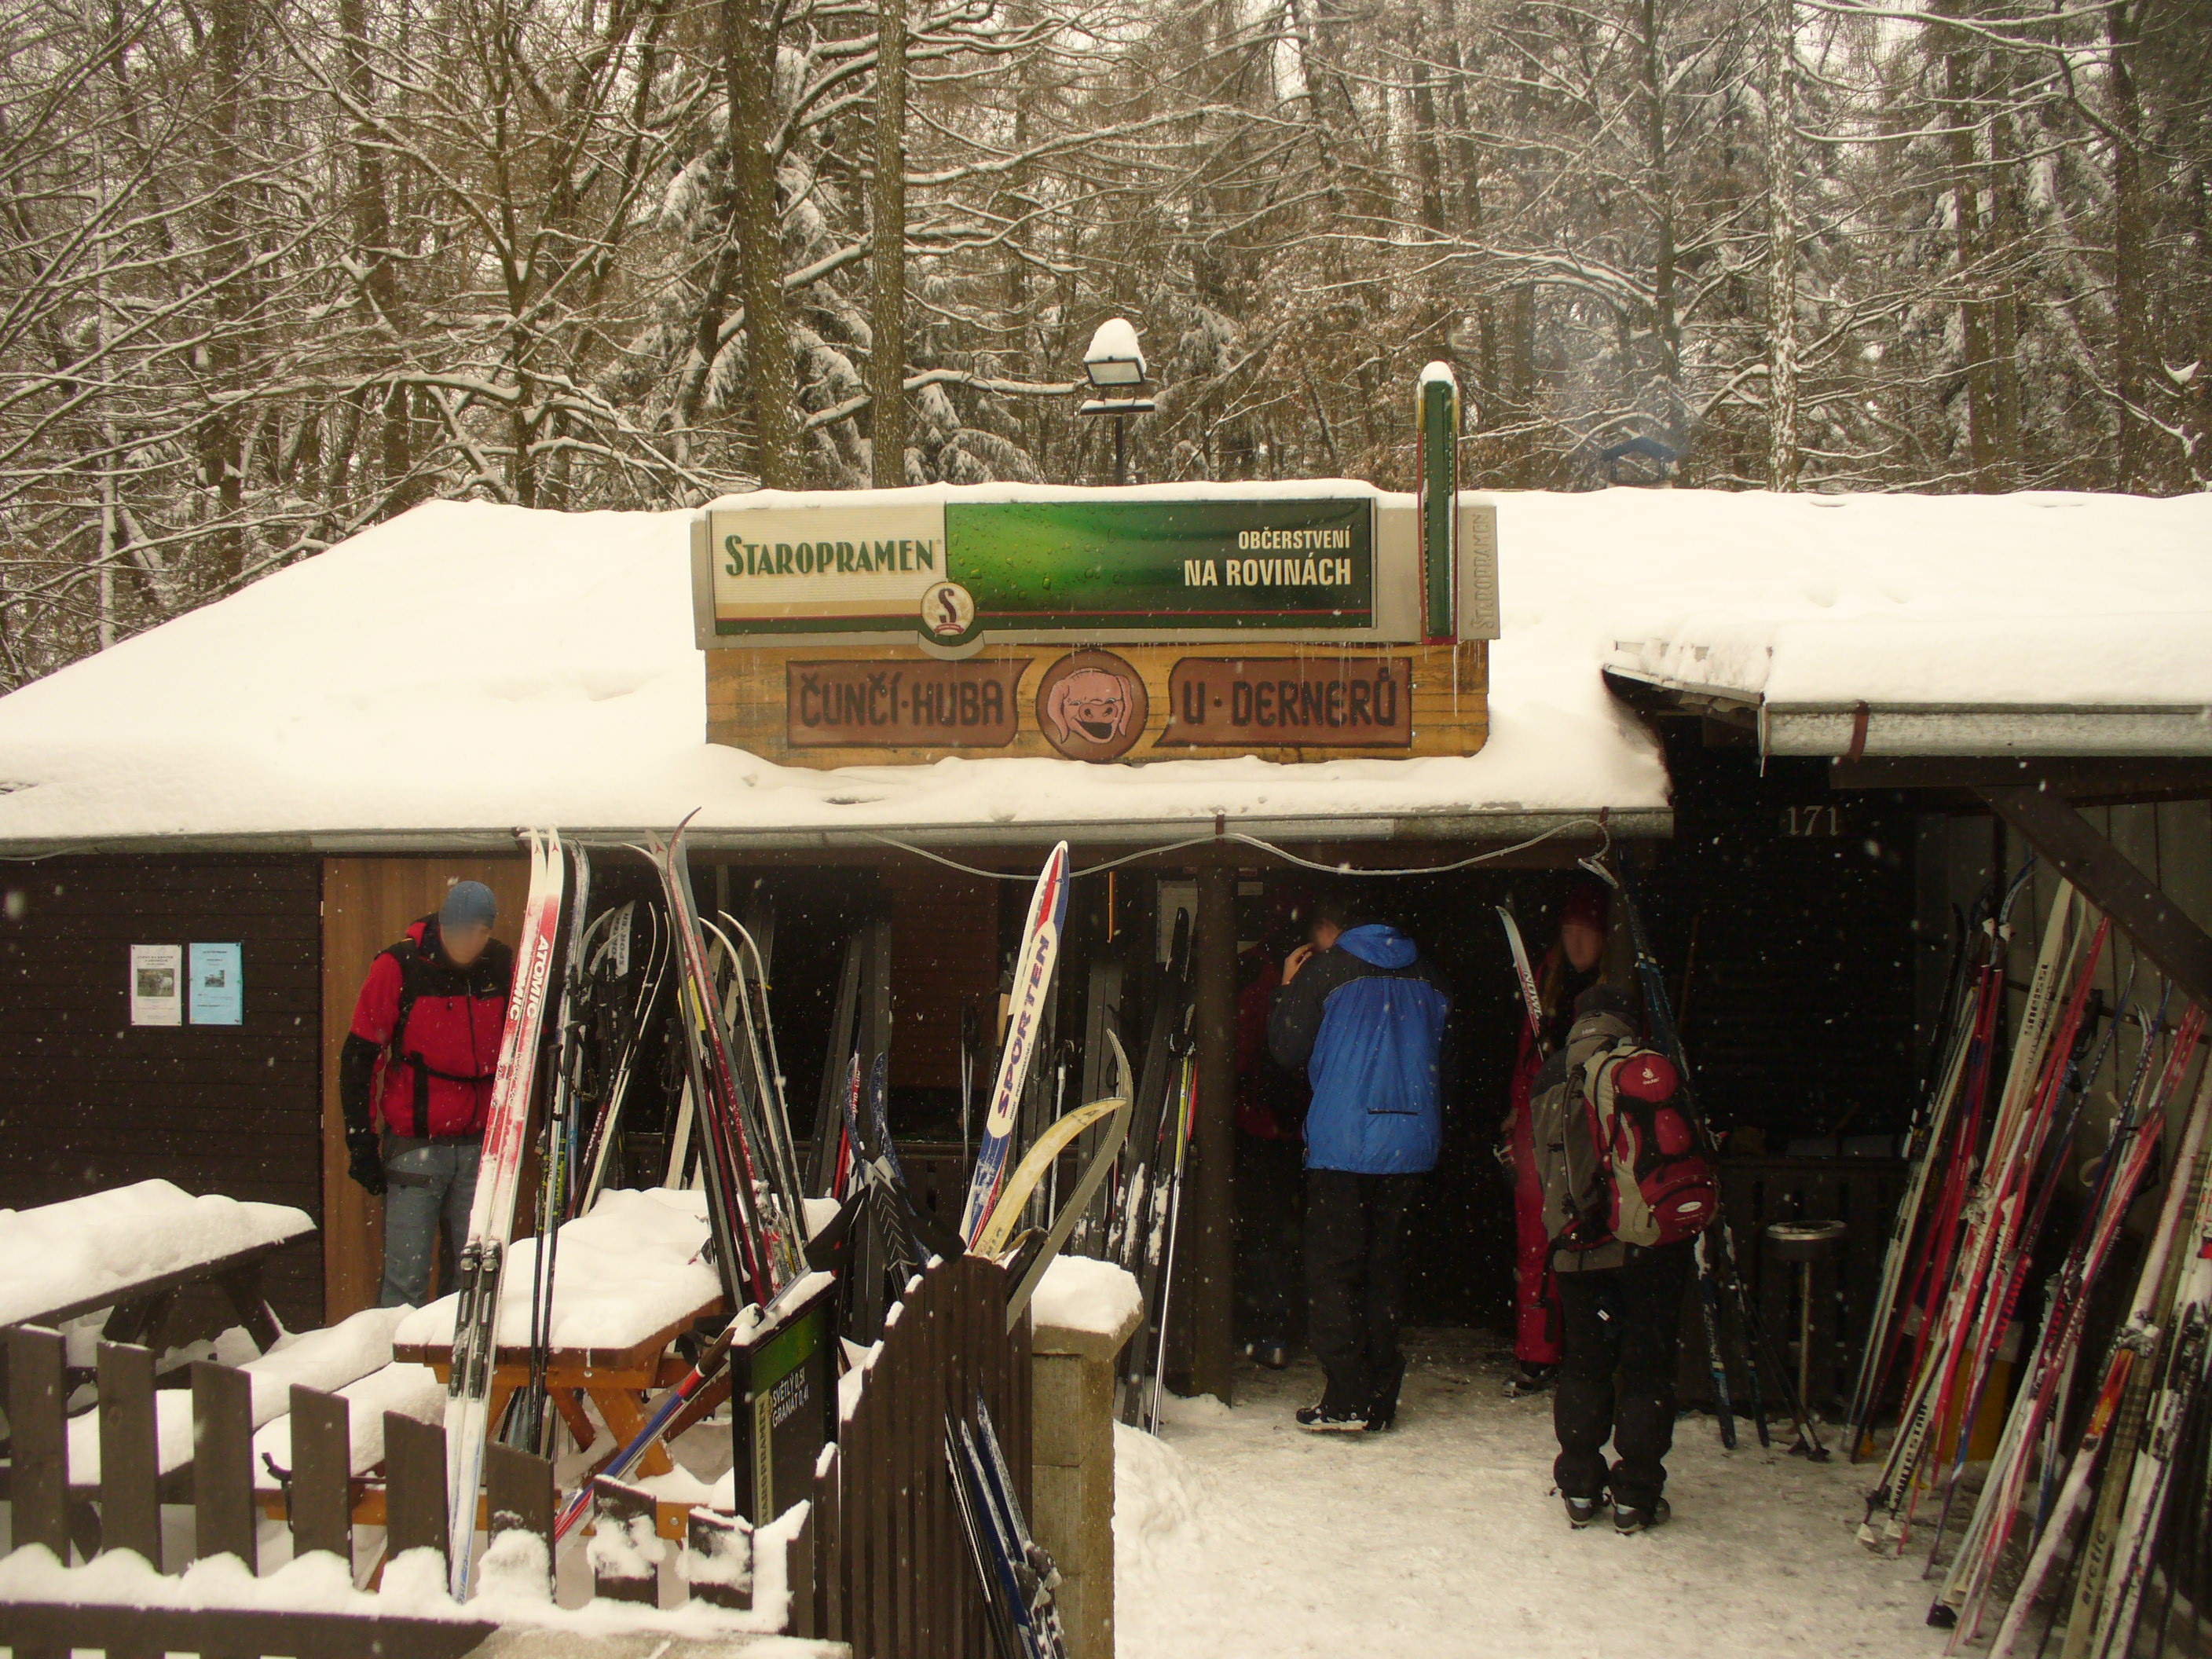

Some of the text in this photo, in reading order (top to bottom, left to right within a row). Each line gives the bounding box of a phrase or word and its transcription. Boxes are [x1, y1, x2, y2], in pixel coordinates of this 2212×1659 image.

[724, 535, 933, 577] STAROPRAMEN
[1238, 526, 1351, 550] OBČERSTVENÍ
[1185, 551, 1351, 586] NA ROVINÁCH
[1470, 513, 1495, 629] STAROPRAMEN
[1232, 666, 1397, 727] DERNERŮ
[1785, 805, 1840, 837] 171
[526, 934, 550, 1019] ATOMIC
[997, 934, 1050, 1119] SPORTEN
